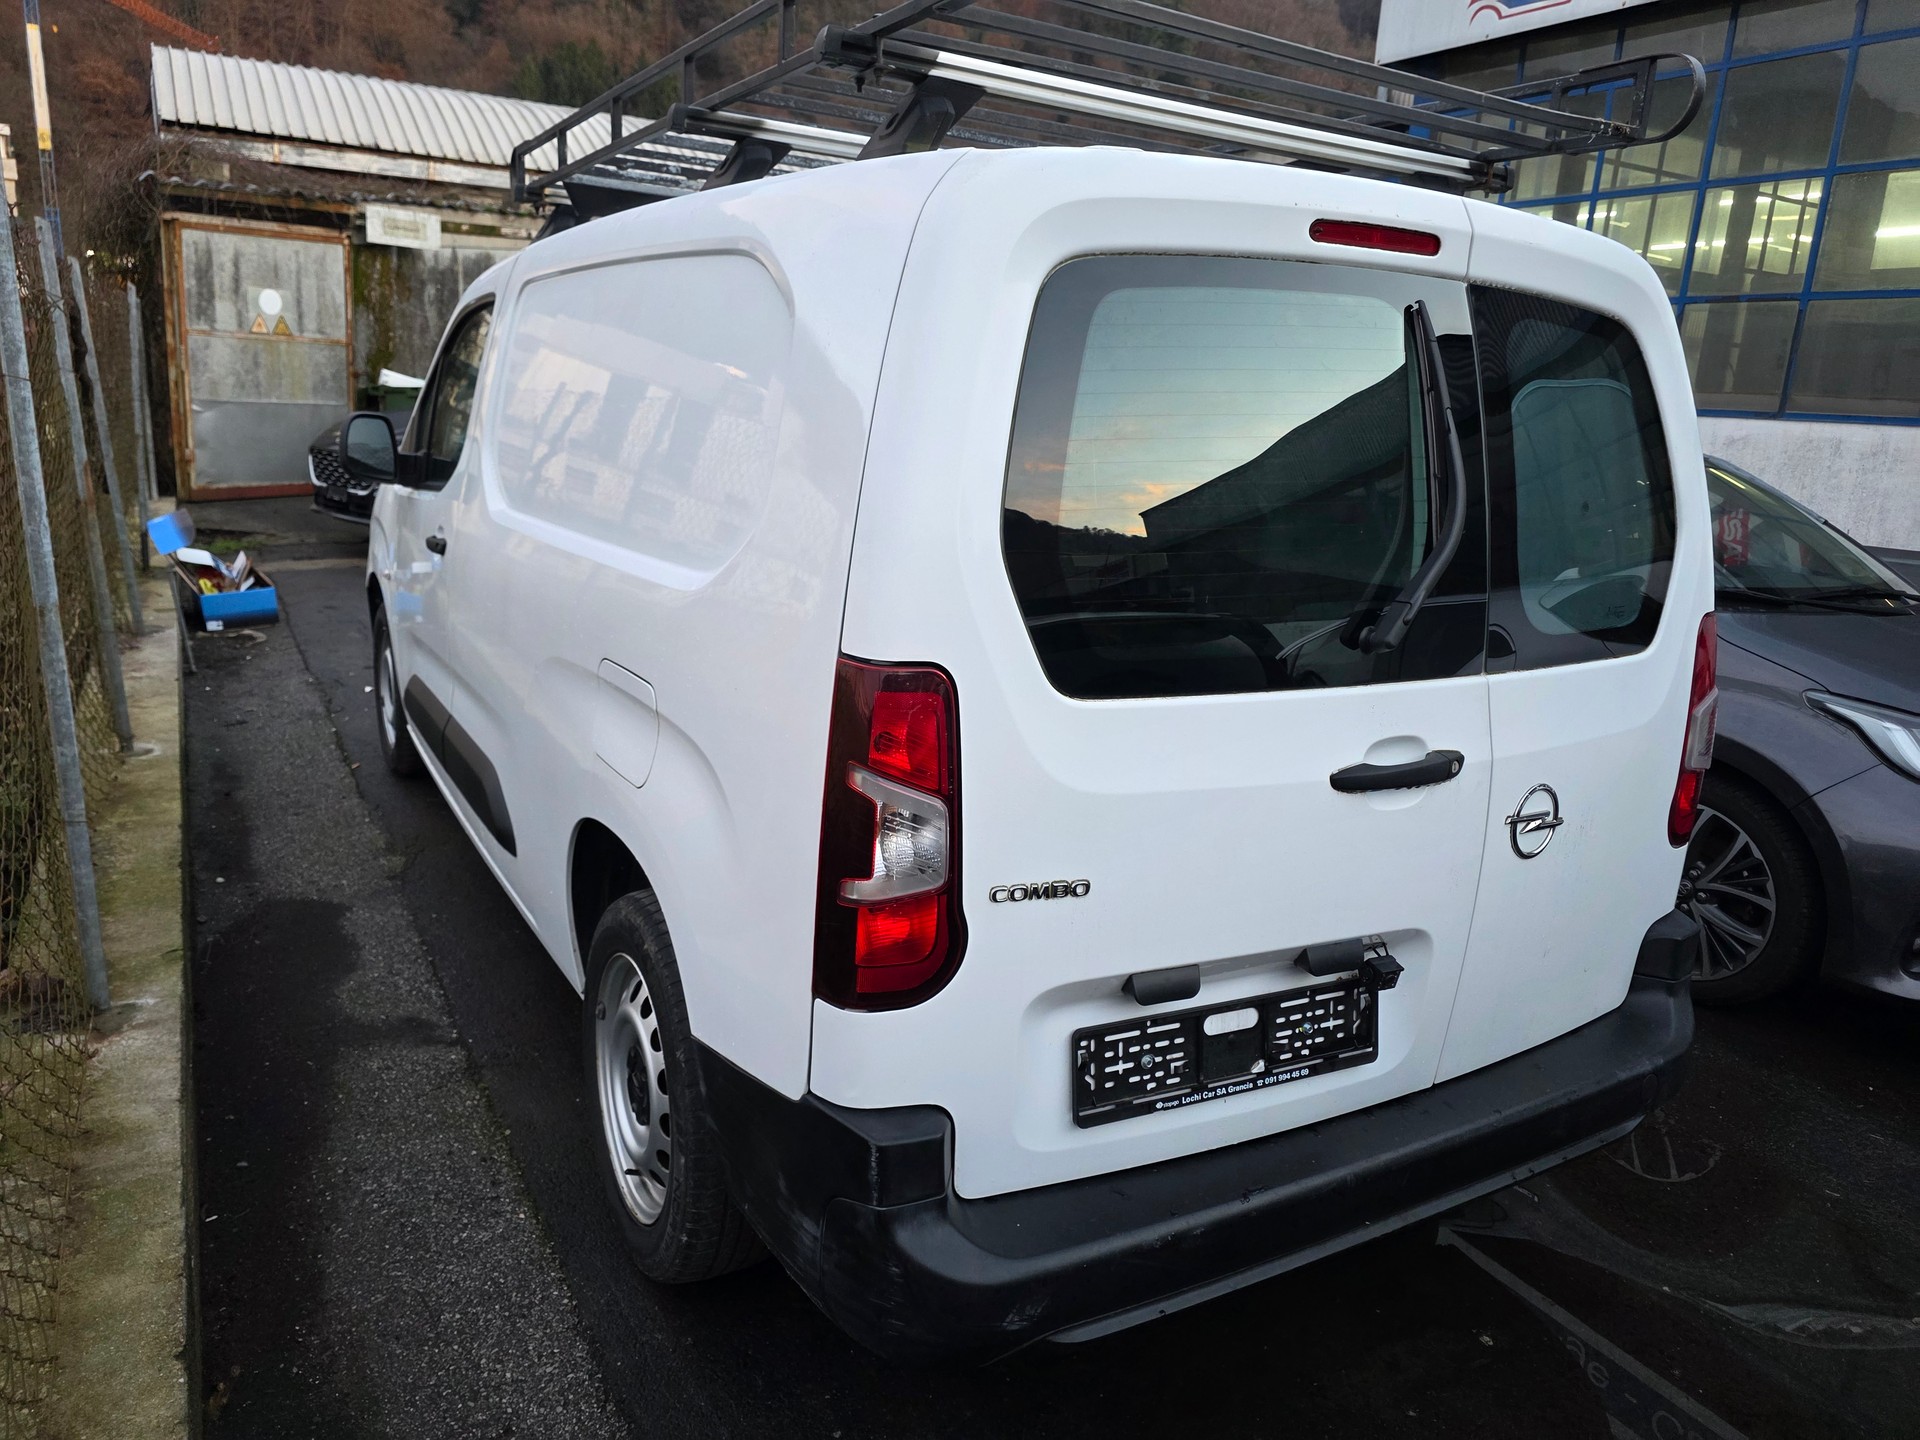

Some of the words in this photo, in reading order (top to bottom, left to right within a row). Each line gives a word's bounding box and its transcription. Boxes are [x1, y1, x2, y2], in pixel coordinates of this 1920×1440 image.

[989, 878, 1091, 903] COMBO
[1182, 1092, 1202, 1104] Lochi
[1202, 1090, 1216, 1100] Car
[1216, 1087, 1227, 1096] SA
[1227, 1081, 1254, 1093] Grancia
[1264, 1075, 1277, 1085] 091
[1278, 1072, 1291, 1082] 994
[1291, 1070, 1300, 1078] 45
[1300, 1068, 1309, 1076] 69
